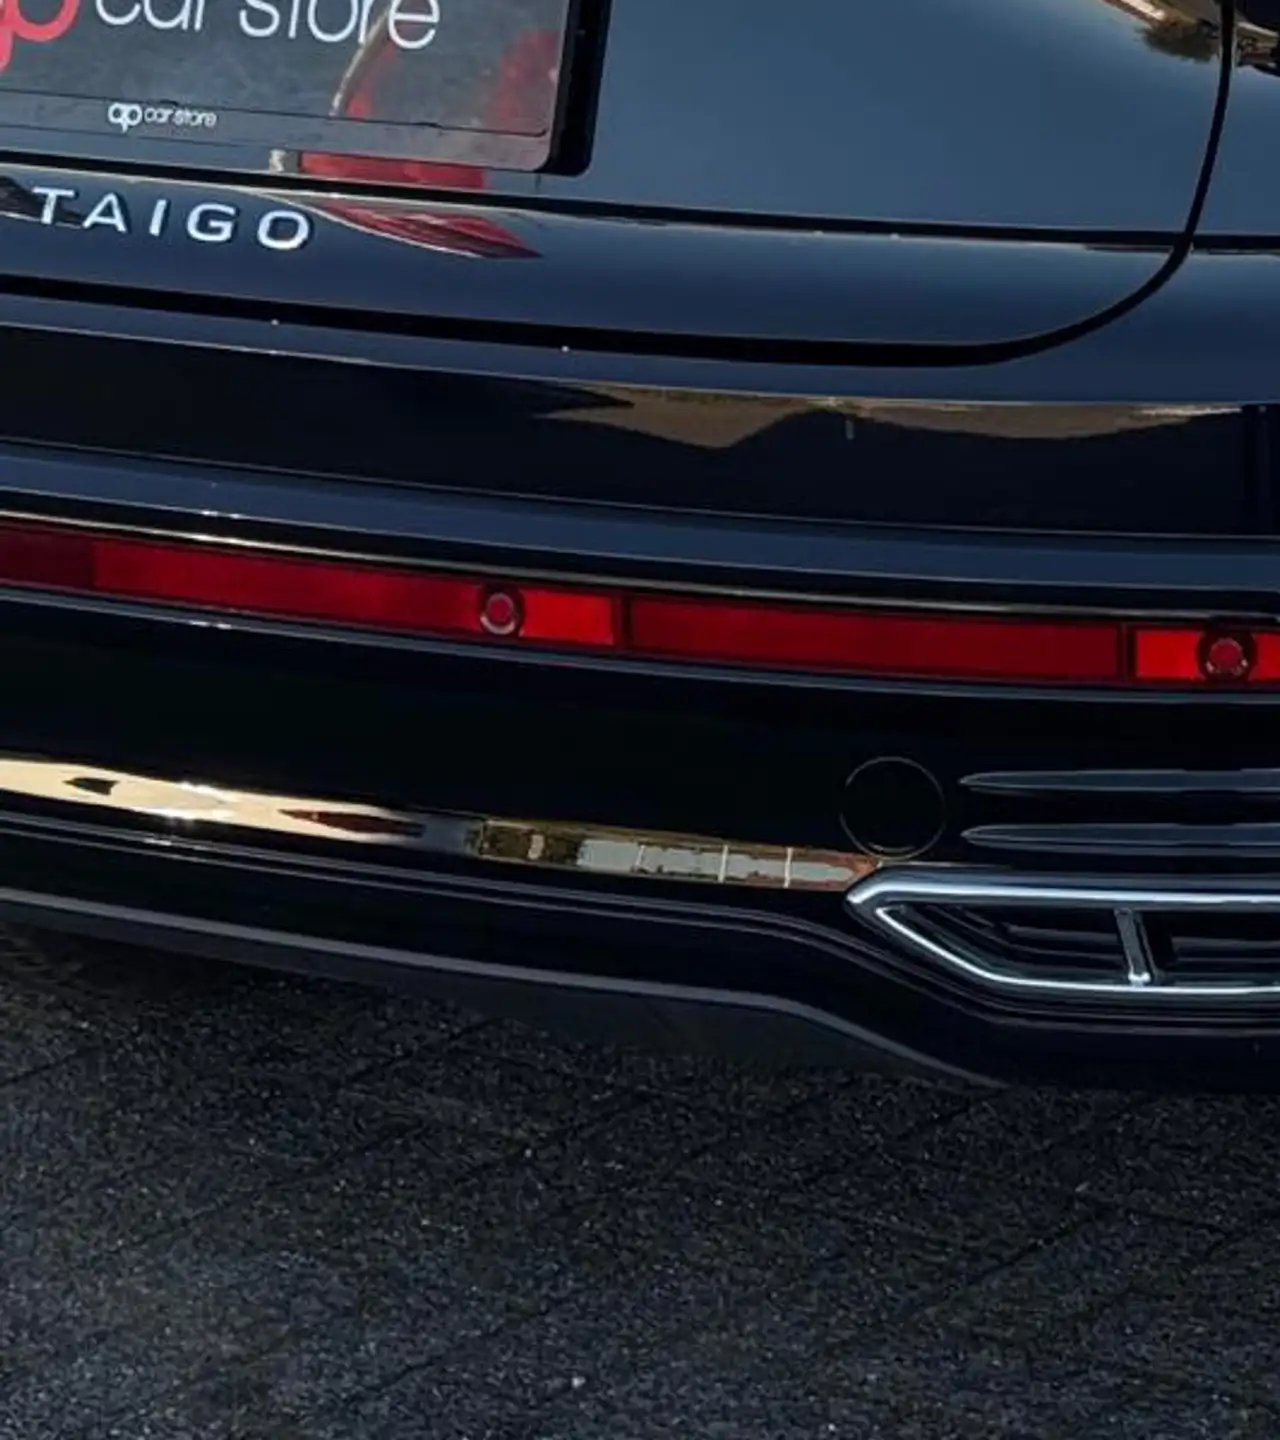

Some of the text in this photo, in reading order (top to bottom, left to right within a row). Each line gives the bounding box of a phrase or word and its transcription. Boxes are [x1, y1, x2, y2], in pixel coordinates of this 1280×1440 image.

[143, 107, 173, 123] car
[173, 107, 218, 129] store
[31, 188, 312, 252] TAIGO
